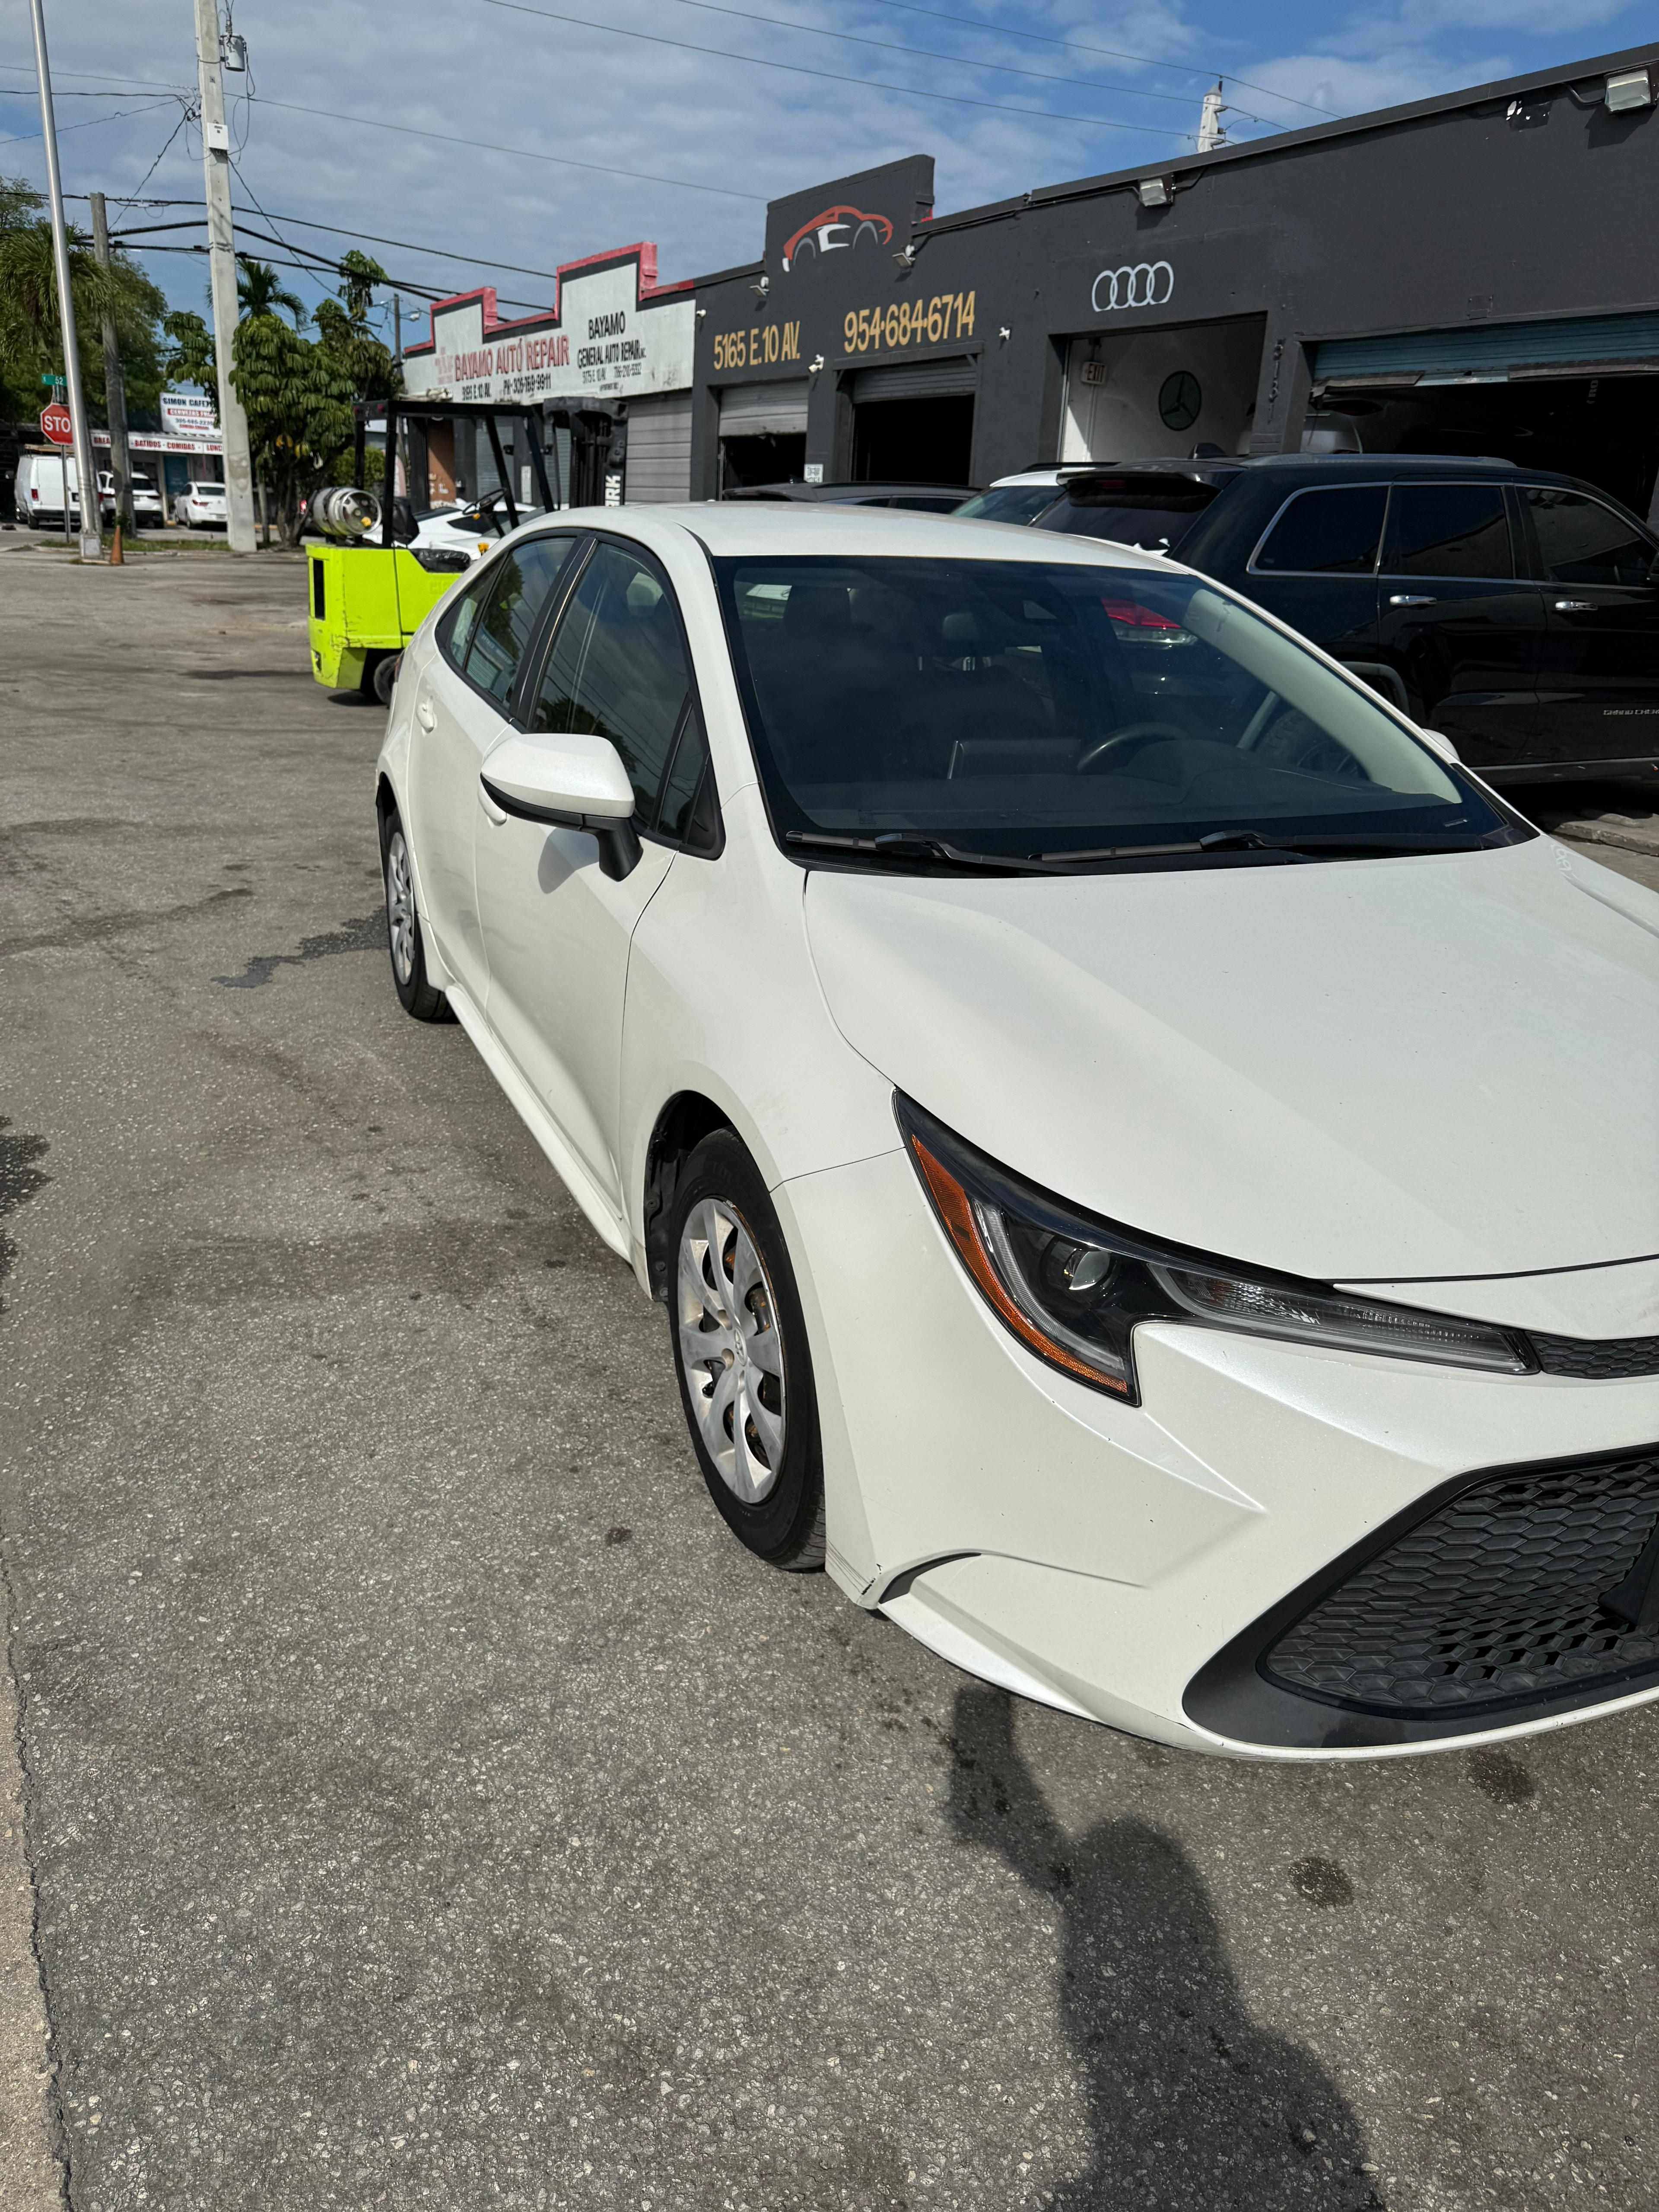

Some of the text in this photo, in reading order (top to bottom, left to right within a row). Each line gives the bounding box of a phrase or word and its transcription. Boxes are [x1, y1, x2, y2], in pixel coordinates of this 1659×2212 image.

[588, 311, 626, 340] BAYAMO
[844, 291, 976, 353] 954-684-6714
[454, 348, 494, 382] BAYAMO
[496, 343, 524, 375] AUTO
[525, 335, 570, 371] REPAIR
[577, 345, 603, 369] GENERAL
[604, 343, 620, 364] AUTO
[621, 339, 641, 362] REPAIR
[714, 330, 746, 370] 5165
[781, 321, 801, 361] AV.
[55, 377, 64, 385] 52
[162, 397, 210, 408] SIMON CAFET
[44, 416, 71, 432] STO
[135, 439, 161, 449] BATIDOS
[166, 442, 195, 451] COMIDAS
[207, 444, 222, 452] LUNC
